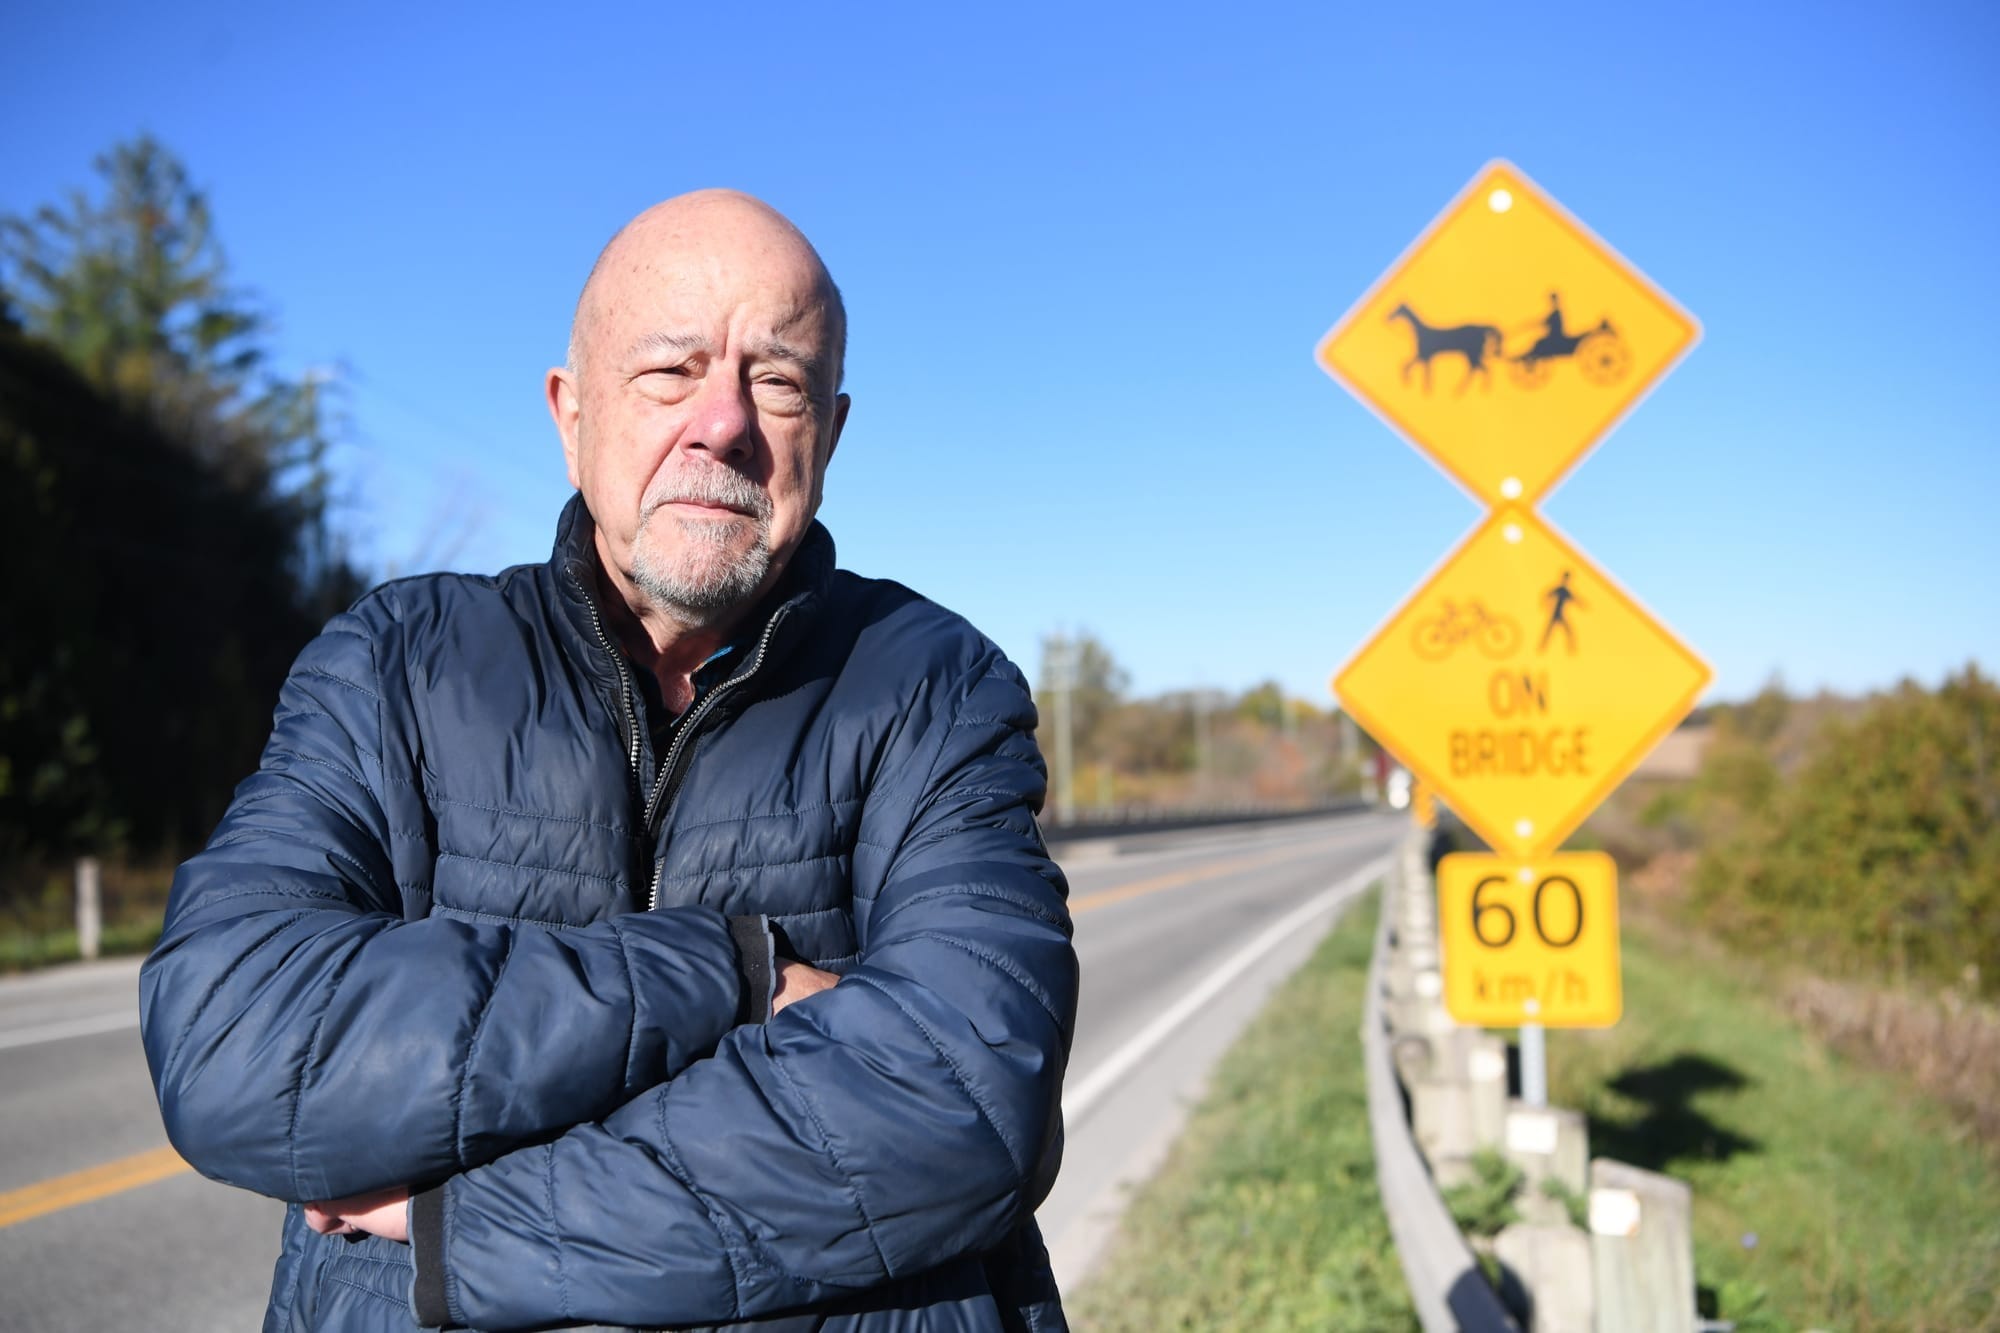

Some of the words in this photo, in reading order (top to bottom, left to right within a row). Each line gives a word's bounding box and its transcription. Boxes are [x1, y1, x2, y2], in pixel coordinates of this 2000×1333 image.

[1489, 671, 1547, 717] ON
[1450, 729, 1592, 775] BRIDGE
[1471, 875, 1584, 948] 60
[1473, 970, 1588, 1000] km/h
